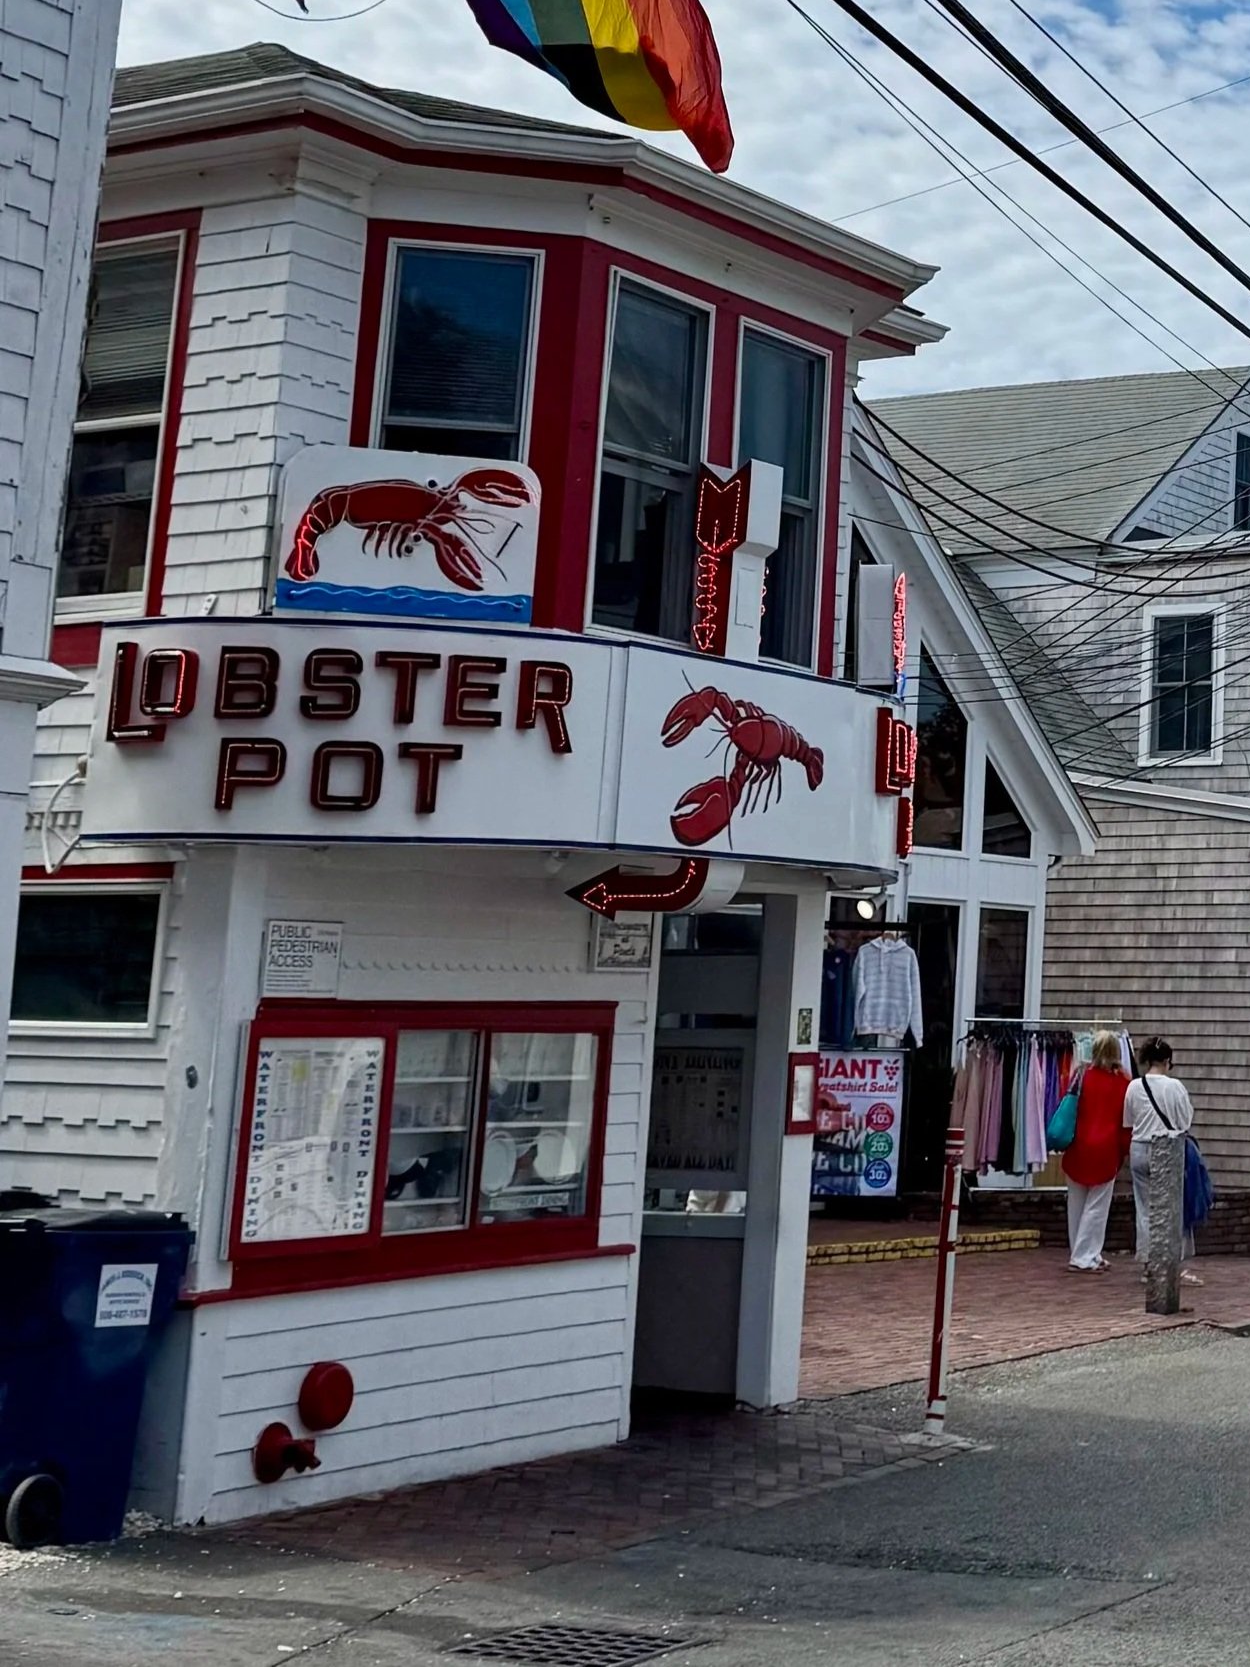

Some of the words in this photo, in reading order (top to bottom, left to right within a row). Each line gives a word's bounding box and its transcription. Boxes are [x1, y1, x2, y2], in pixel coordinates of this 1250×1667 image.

[106, 642, 573, 754] LOBSTER
[214, 737, 464, 814] POT
[269, 954, 313, 968] ACCESS
[270, 940, 337, 954] PEDESTRIAN
[271, 924, 312, 939] PUBLIC
[251, 1050, 274, 1163] WATERFRONT
[358, 1050, 380, 1157] WATERFRONT
[244, 1175, 262, 1238] DINING
[351, 1170, 369, 1230] DINING
